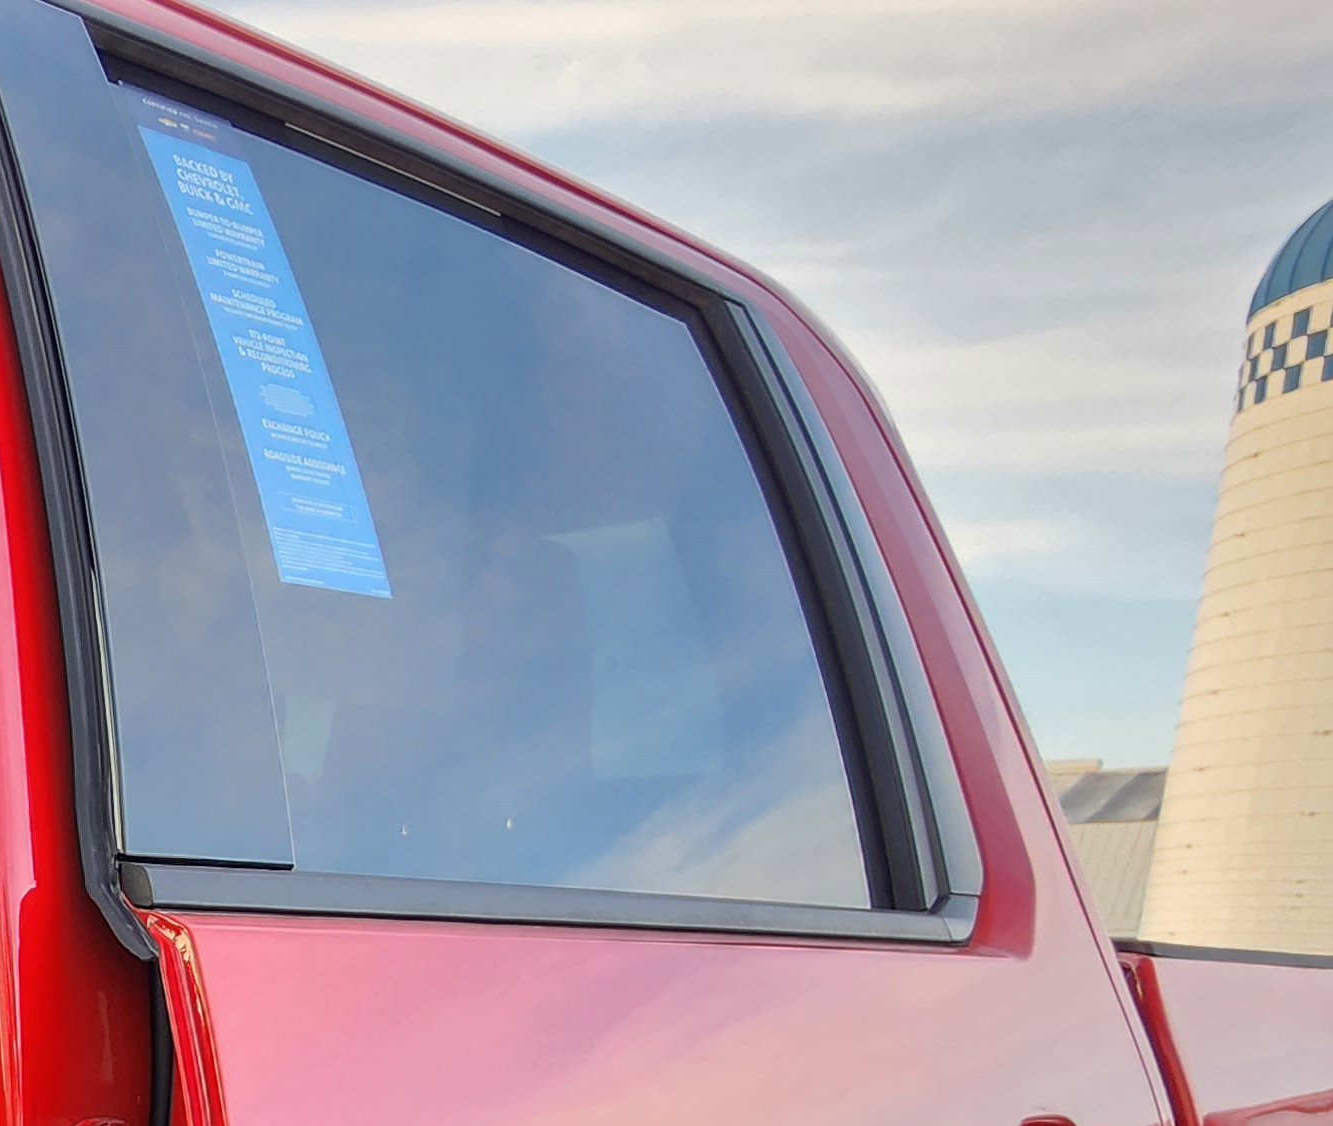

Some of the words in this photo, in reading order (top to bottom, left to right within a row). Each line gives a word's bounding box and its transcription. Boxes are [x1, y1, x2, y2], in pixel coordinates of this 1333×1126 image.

[173, 154, 218, 178] BACKED
[219, 170, 233, 183] BY
[177, 168, 244, 200] CHEVROLET,
[177, 180, 214, 202] BUICK
[214, 192, 226, 206] &
[226, 197, 253, 215] GMC
